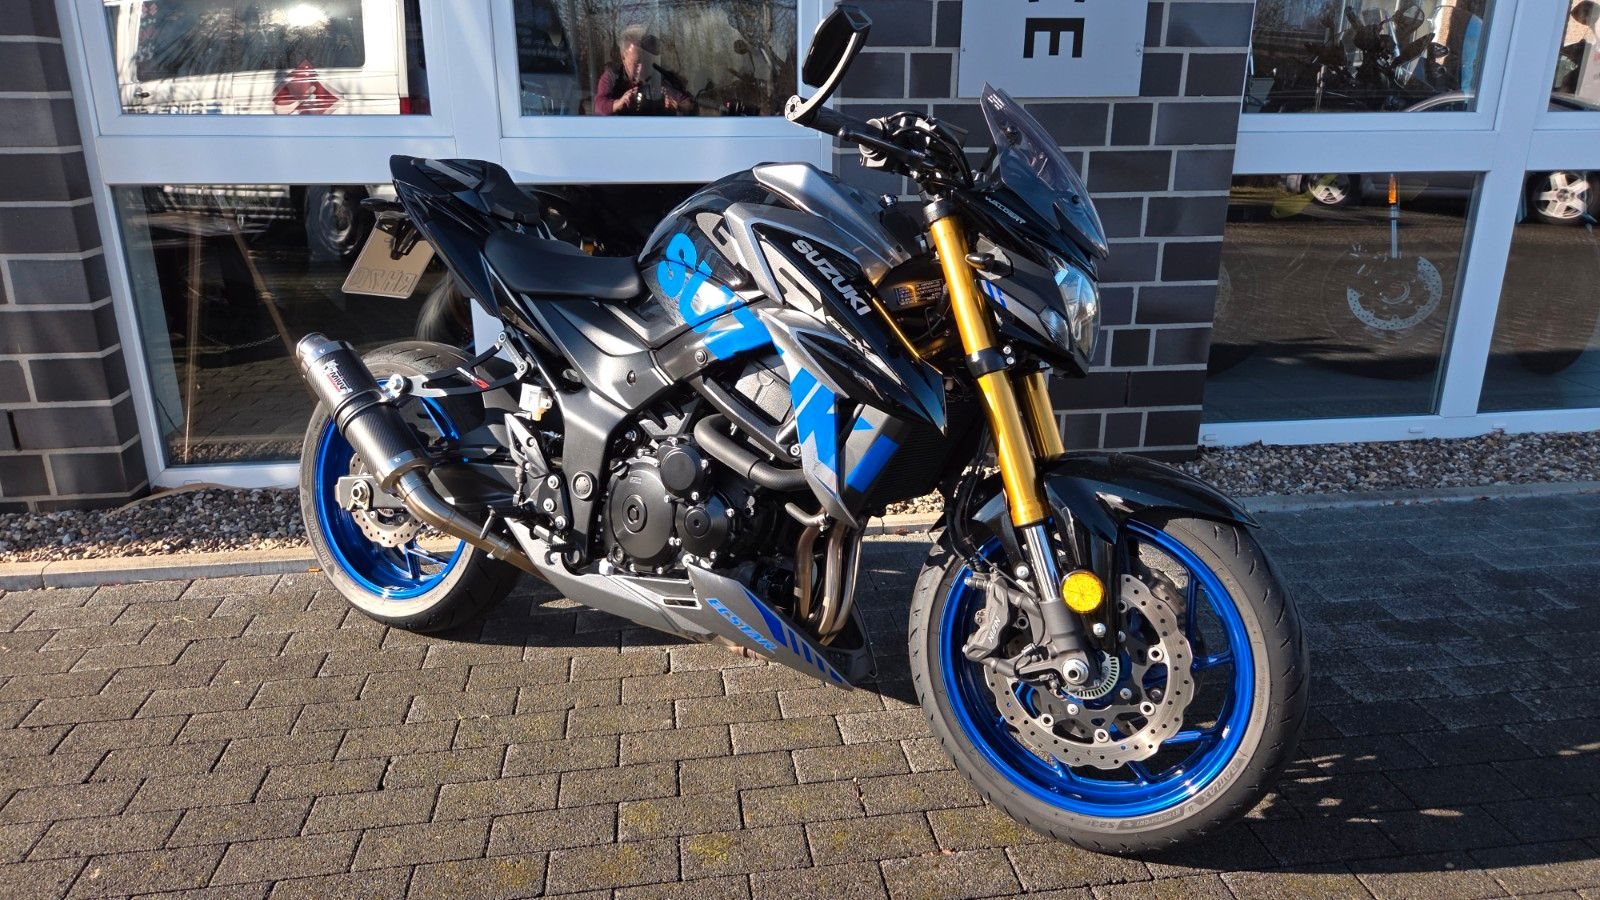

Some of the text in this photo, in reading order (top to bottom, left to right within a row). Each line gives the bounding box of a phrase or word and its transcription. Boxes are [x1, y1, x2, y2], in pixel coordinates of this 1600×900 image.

[1023, 0, 1085, 58] E
[791, 239, 871, 316] SUZUKI
[705, 598, 777, 654] ECSTAR
